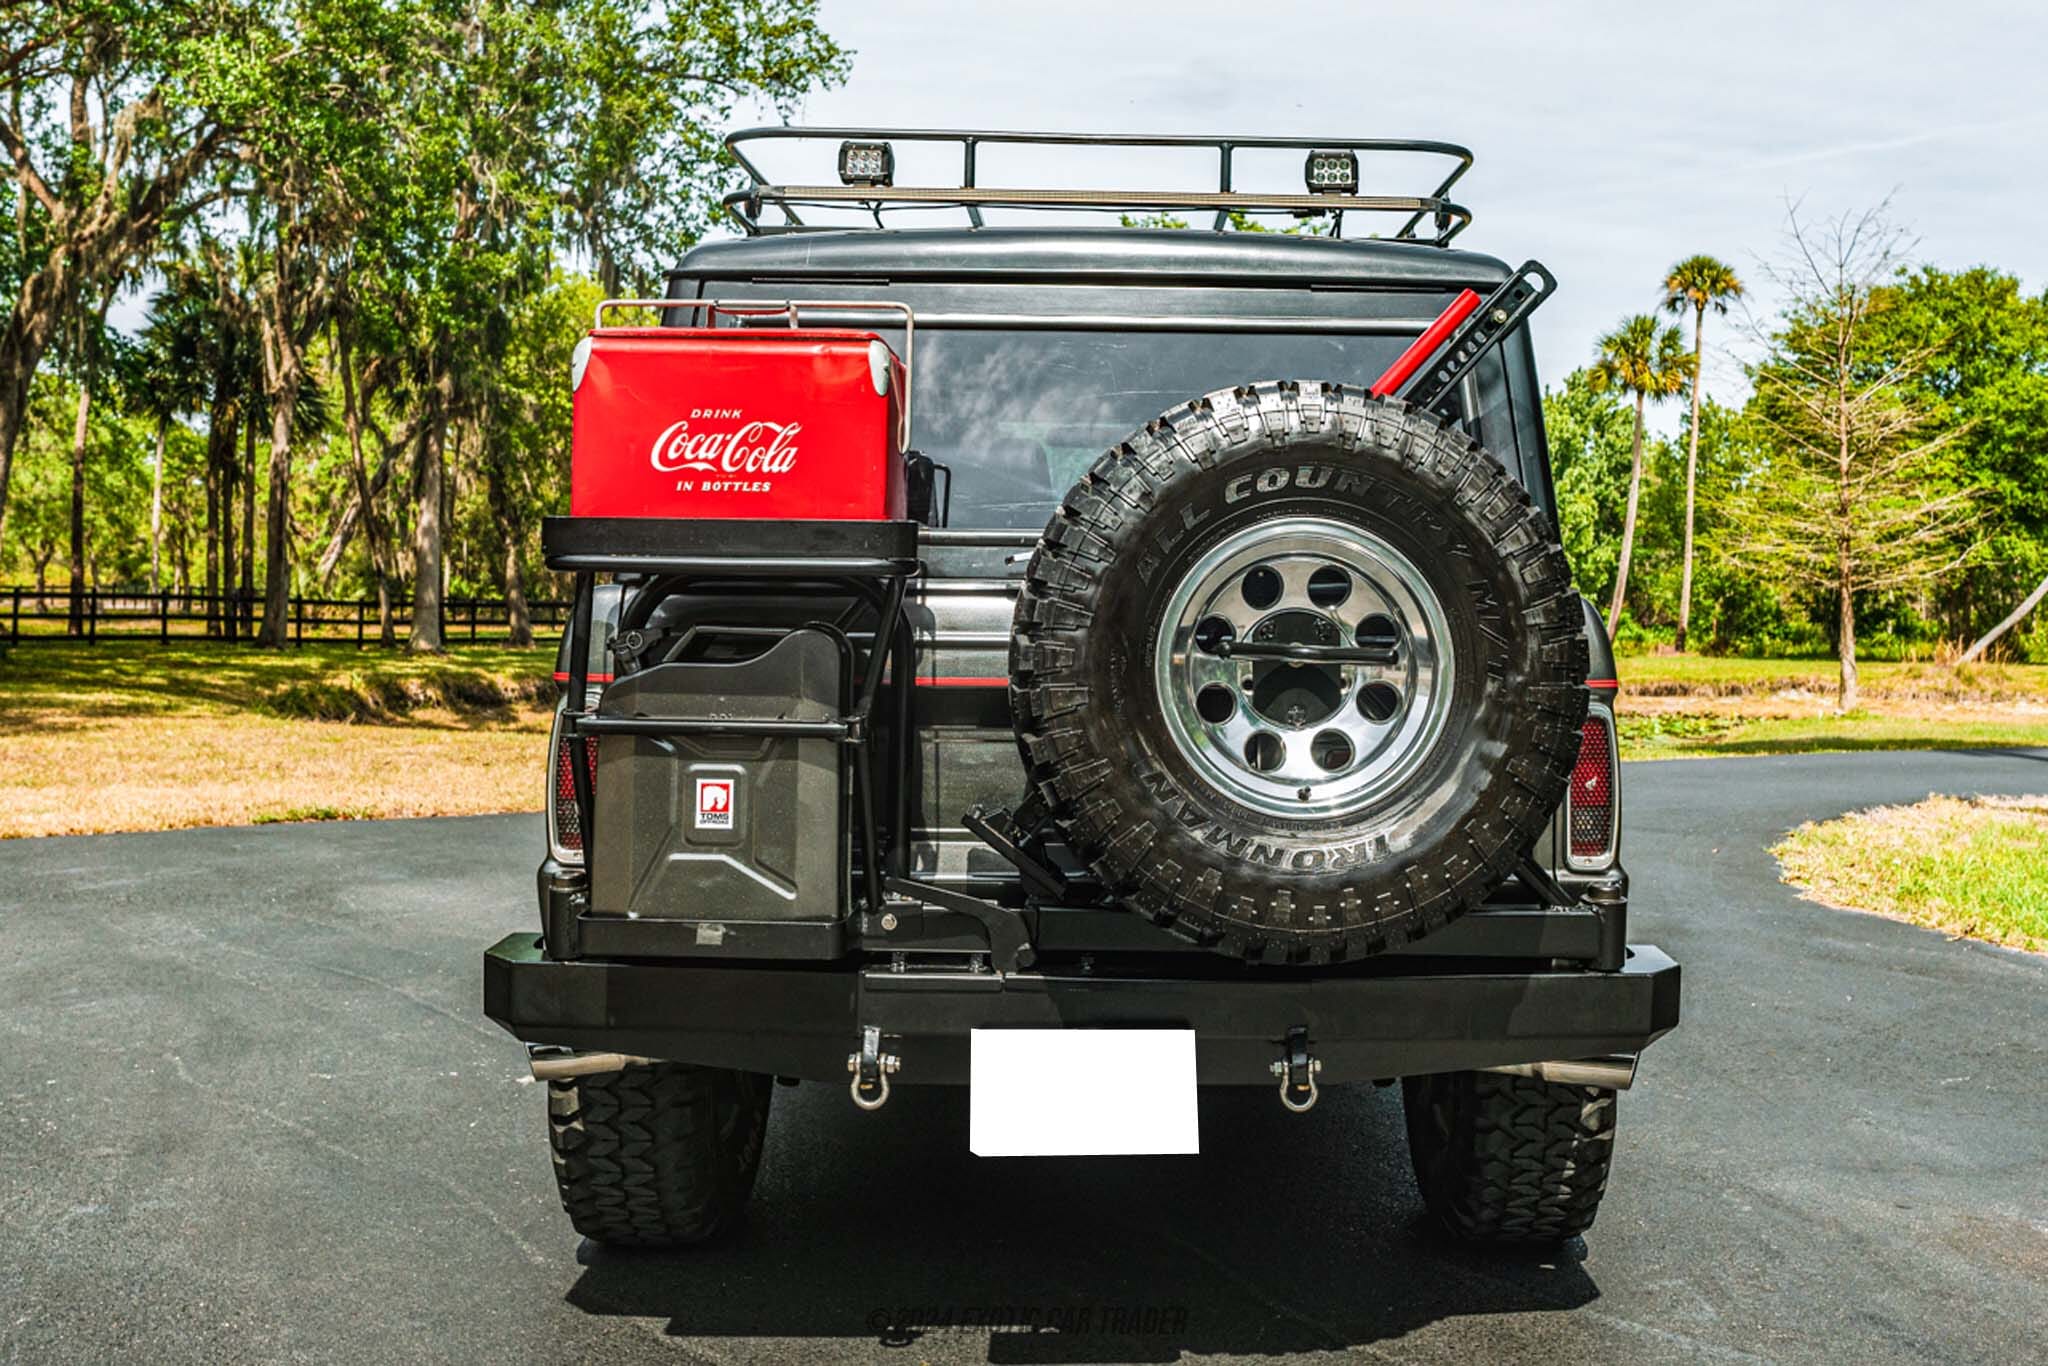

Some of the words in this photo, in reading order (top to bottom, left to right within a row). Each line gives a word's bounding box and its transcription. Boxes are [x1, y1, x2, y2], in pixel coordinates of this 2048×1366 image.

[690, 408, 743, 419] DRINK
[650, 420, 802, 473] Coca-Cola
[676, 481, 693, 491] IN
[701, 481, 772, 492] BOTTLES
[1136, 502, 1211, 586] ALL
[1140, 772, 1391, 869] IRONMAN
